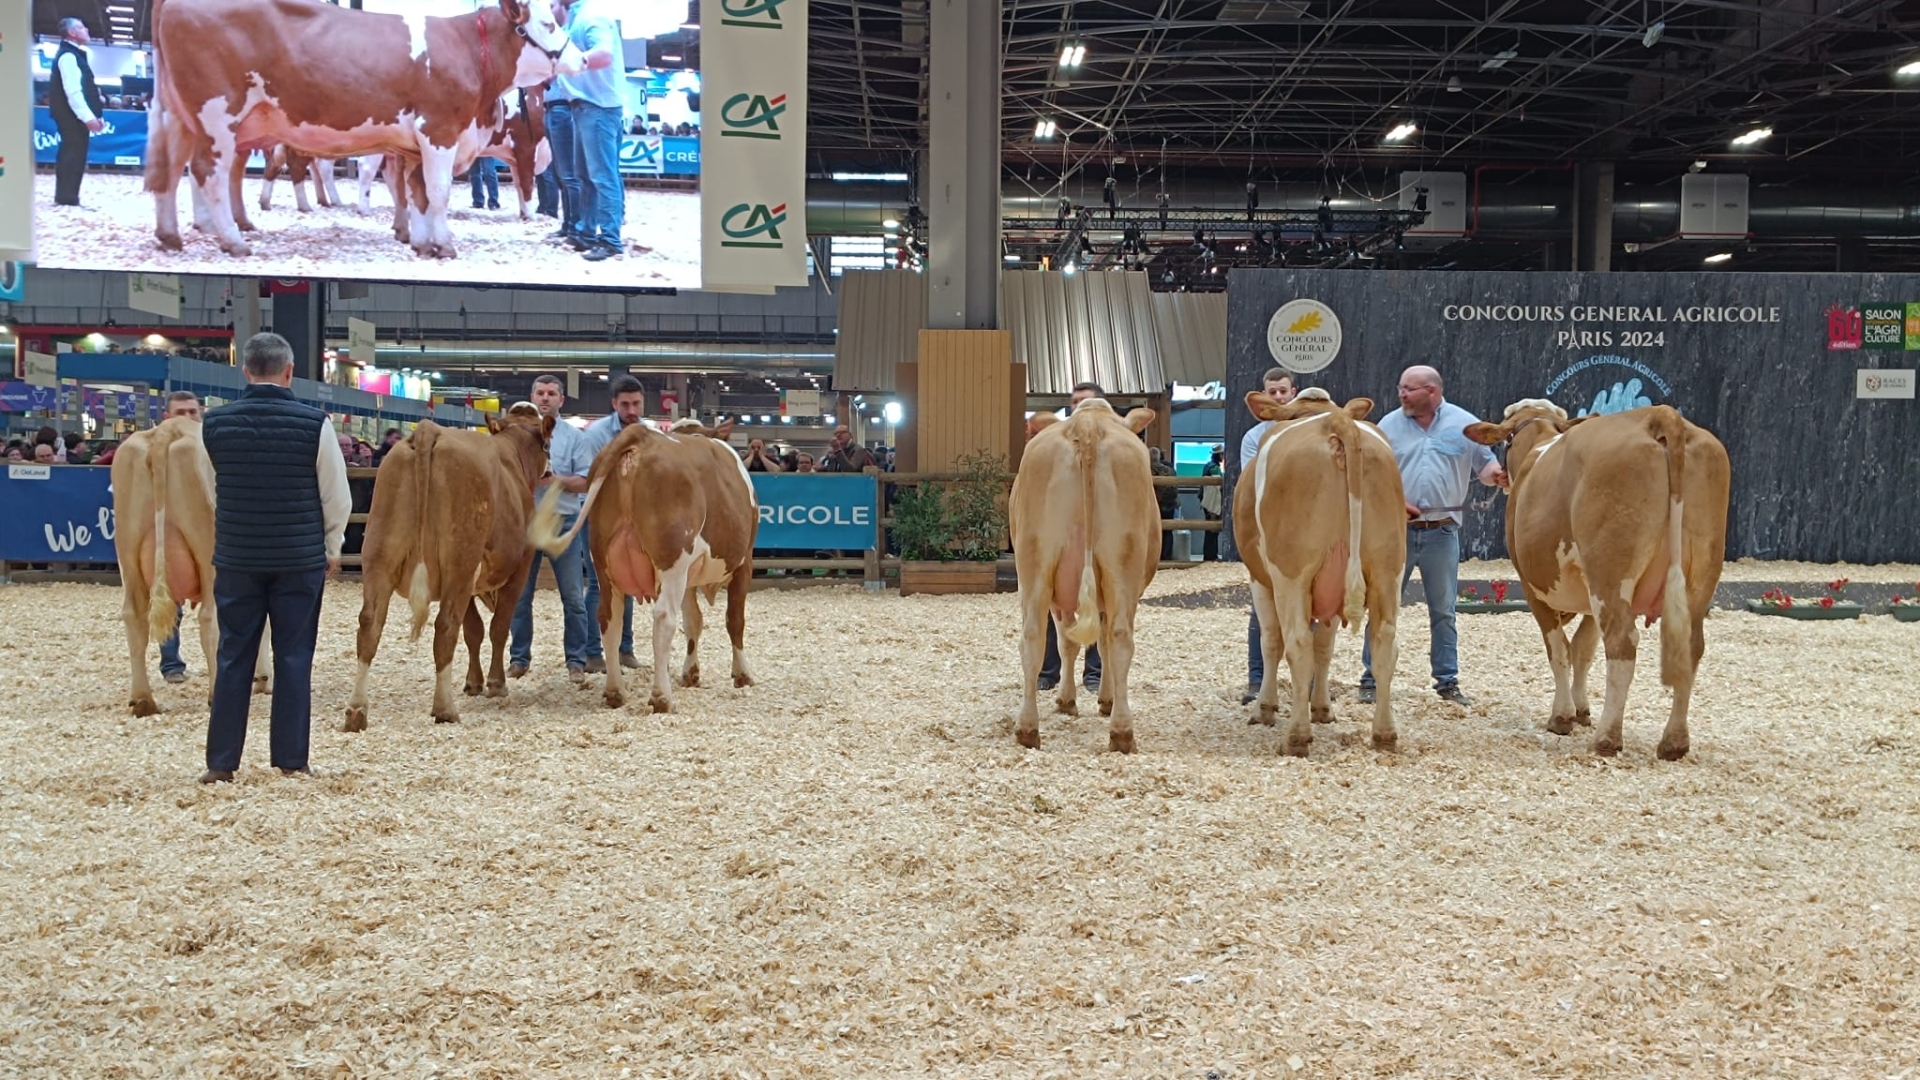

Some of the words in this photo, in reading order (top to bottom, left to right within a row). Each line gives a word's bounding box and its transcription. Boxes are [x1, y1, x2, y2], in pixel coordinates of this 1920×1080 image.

[1443, 305, 1564, 322] CONCOURS
[1570, 305, 1667, 322] GENERAL
[1672, 306, 1781, 323] AGRICOLE
[1865, 309, 1902, 320] SALON
[1276, 335, 1333, 344] CONCOURS
[1558, 324, 1613, 350] PARIS
[1620, 331, 1665, 347] 2024
[1865, 334, 1900, 343] CULTURE
[1631, 360, 1672, 397] AGRICOLE
[44, 520, 92, 553] We
